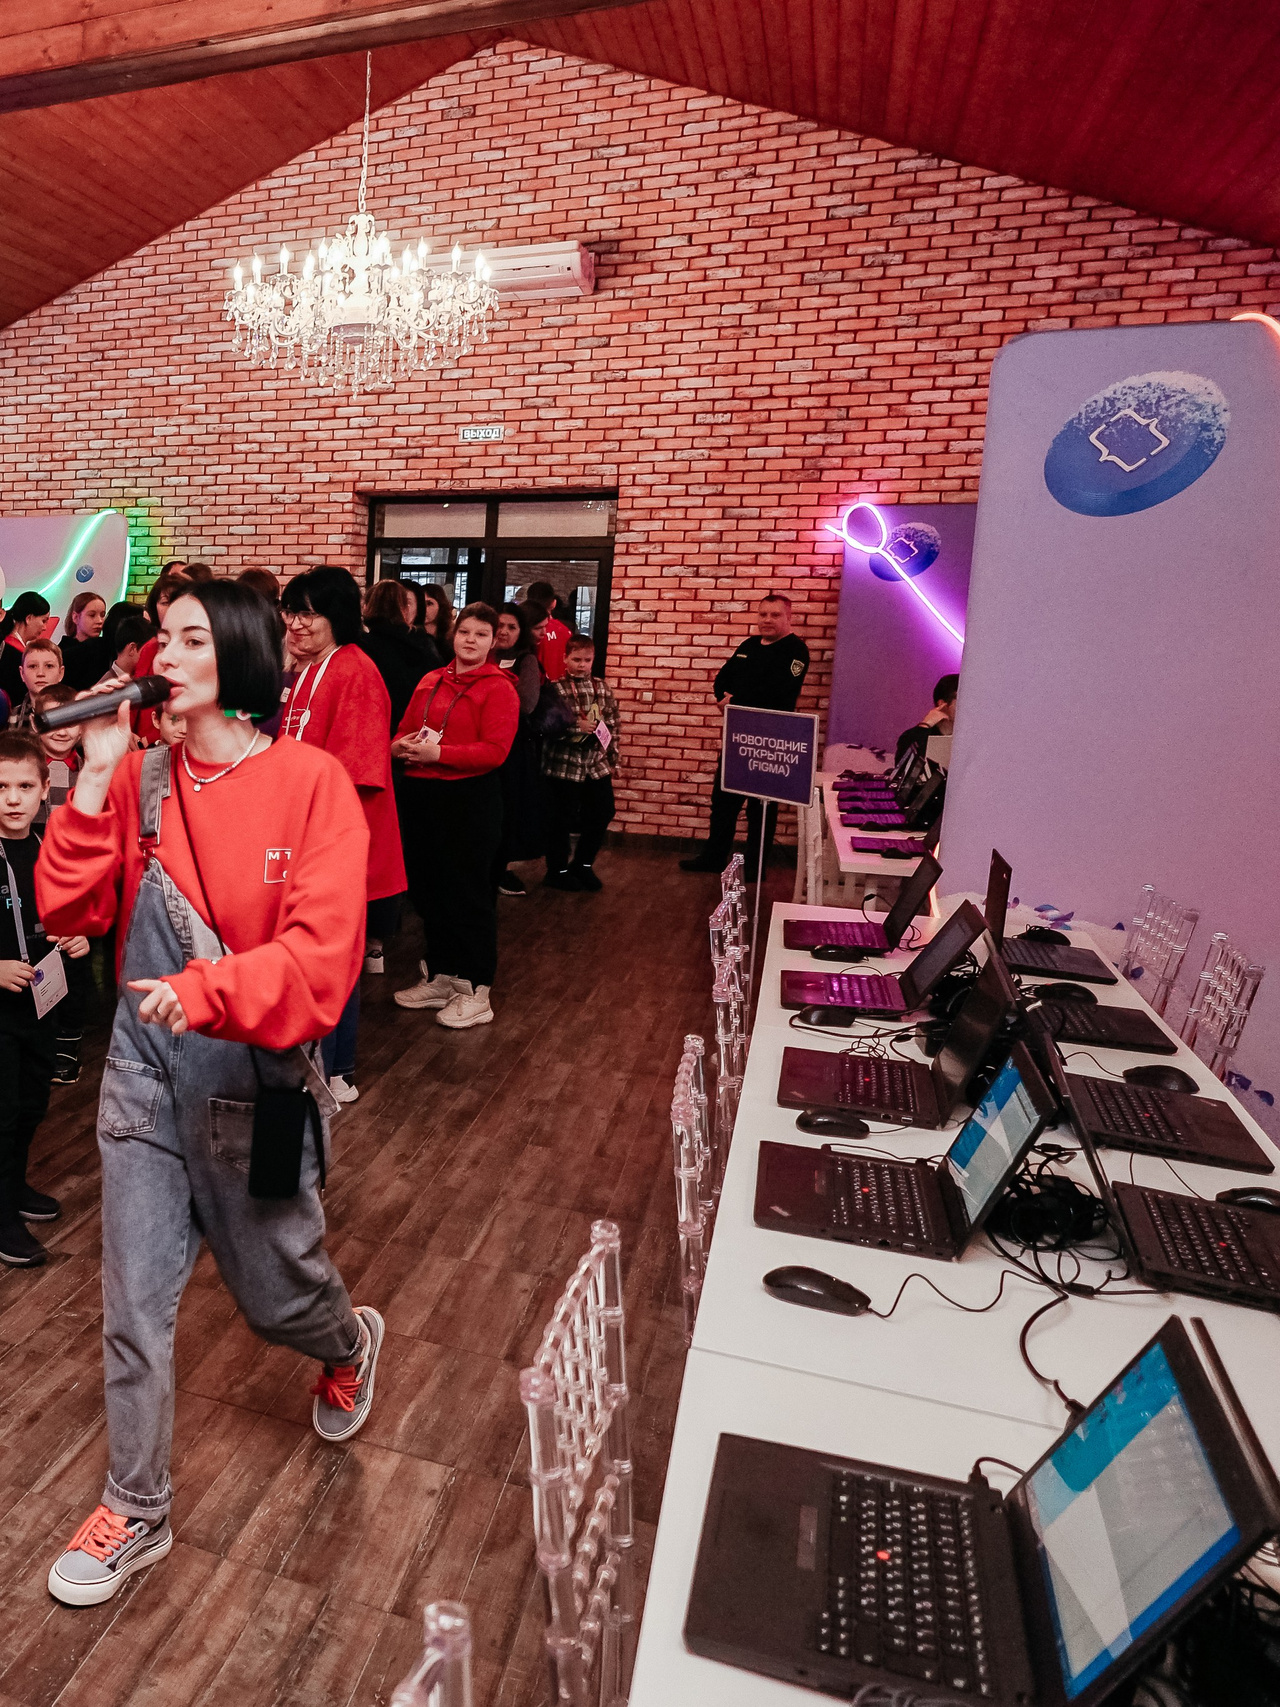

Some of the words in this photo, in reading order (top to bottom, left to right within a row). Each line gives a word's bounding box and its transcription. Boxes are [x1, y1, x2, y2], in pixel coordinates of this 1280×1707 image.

[463, 428, 500, 438] ВЫХОД
[732, 733, 808, 753] НОВОГОДНИЕ
[739, 746, 799, 764] ОТКРЫТКИ
[748, 758, 790, 777] (FIGMA)
